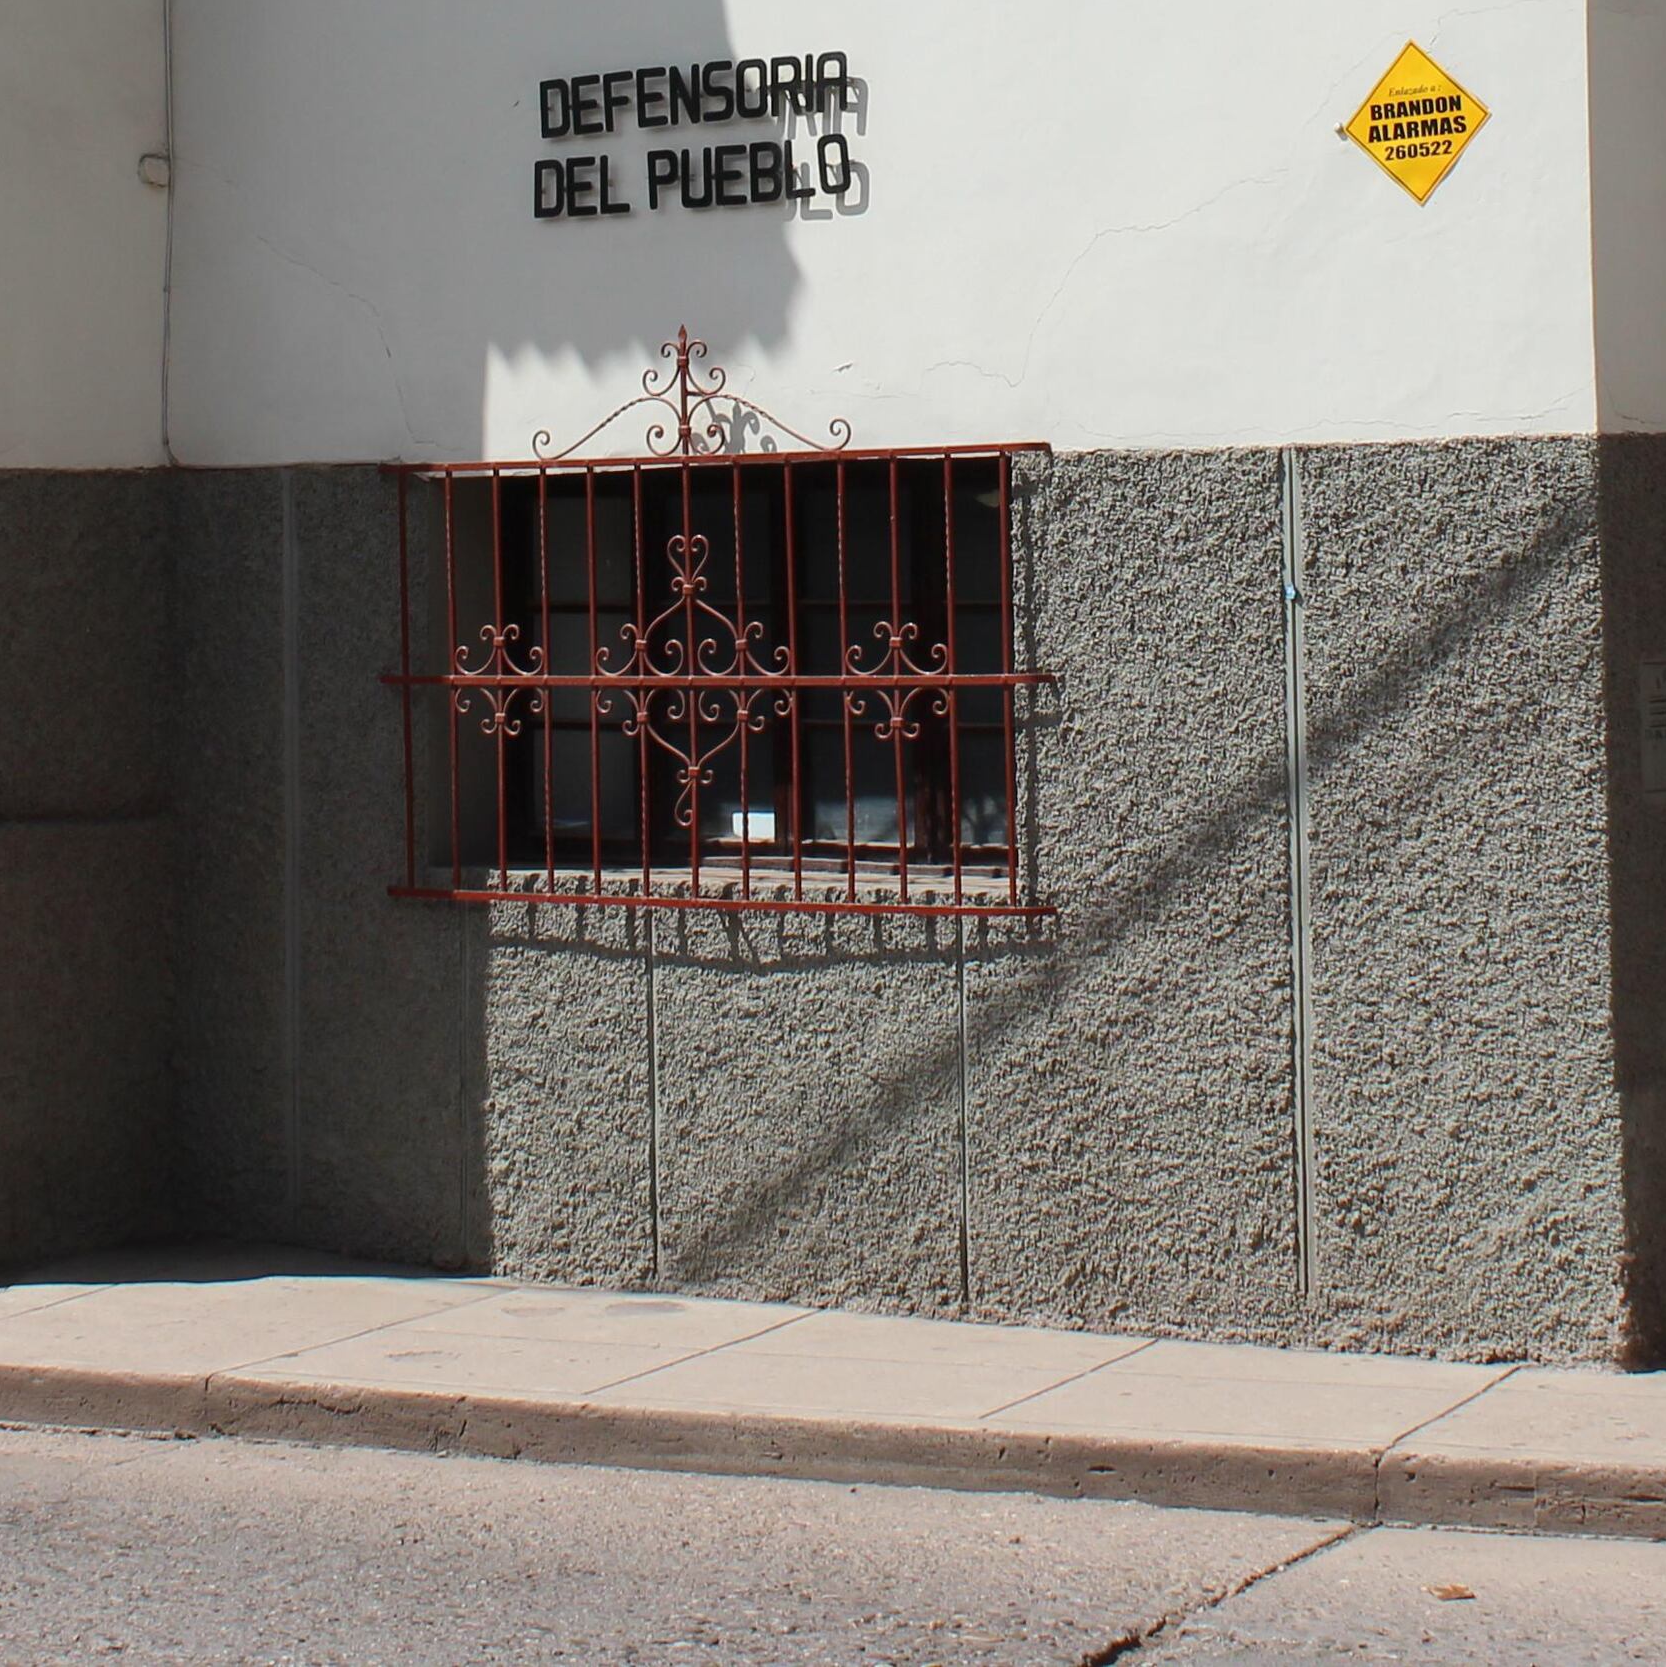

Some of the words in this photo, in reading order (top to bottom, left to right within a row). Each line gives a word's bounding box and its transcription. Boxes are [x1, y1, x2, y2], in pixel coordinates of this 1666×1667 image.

[539, 50, 848, 139] DEFENSORIA
[1370, 94, 1462, 122] BRANDON
[1368, 115, 1467, 143] ALARMAS
[1385, 139, 1453, 162] 260522
[534, 154, 631, 219] DEL
[647, 133, 851, 210] PUEBLO
